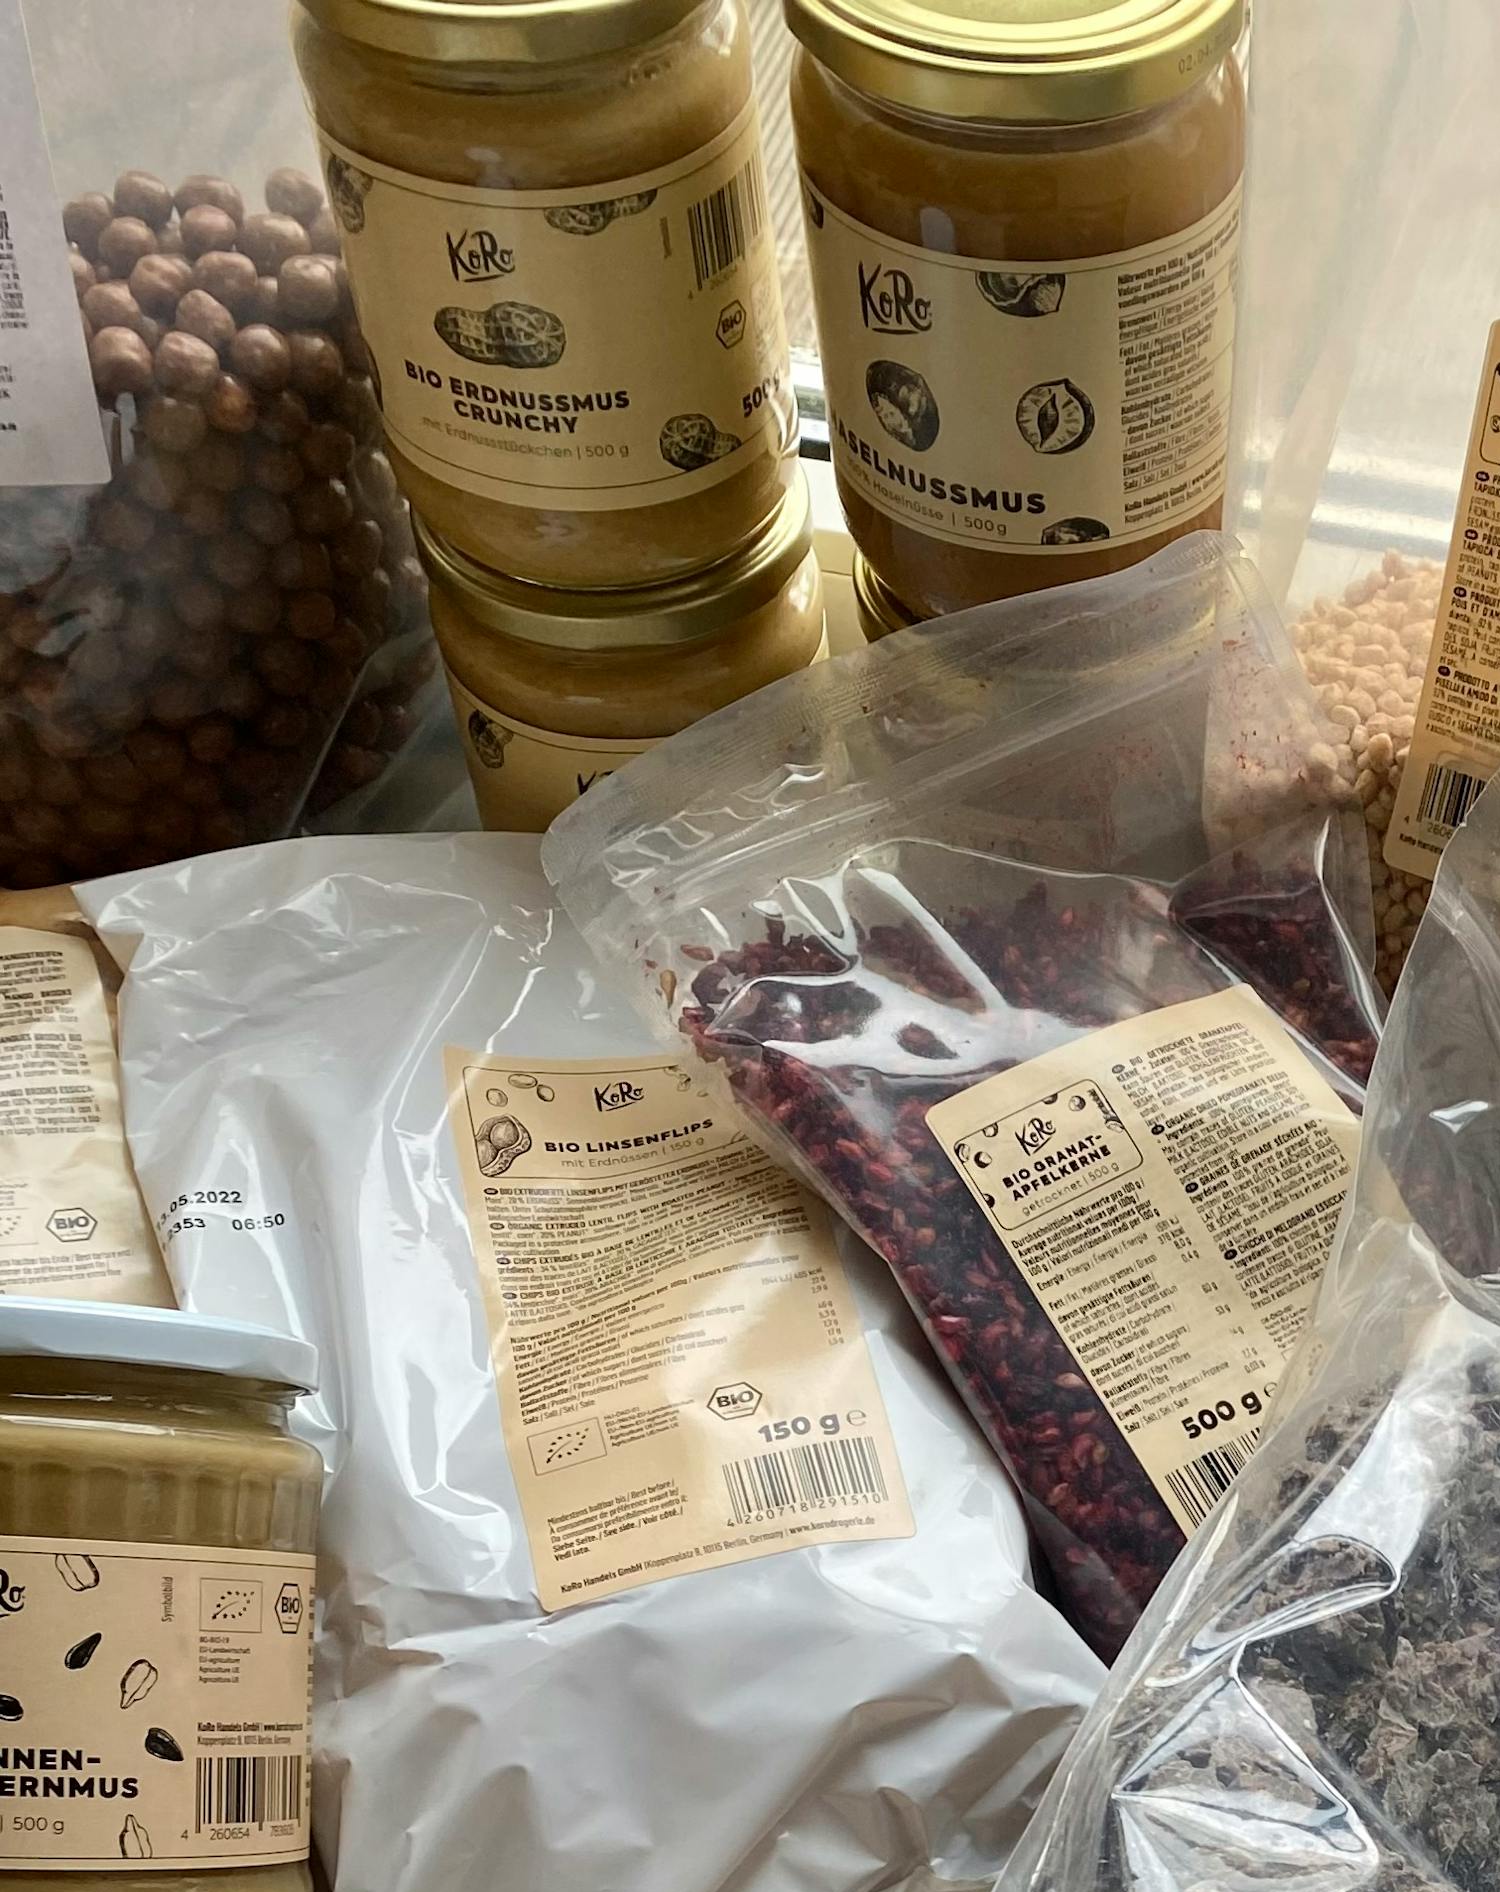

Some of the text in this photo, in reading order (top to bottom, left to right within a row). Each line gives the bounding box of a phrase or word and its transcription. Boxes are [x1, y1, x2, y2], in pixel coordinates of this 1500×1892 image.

[446, 229, 516, 282] KoRo
[858, 261, 932, 334] KoRo
[721, 309, 743, 334] BIO
[404, 359, 631, 411] BIO ERDNUSSMUS
[454, 400, 578, 433] CRUNCHY
[585, 445, 615, 458] 500
[594, 1081, 644, 1111] KoRo
[545, 1118, 714, 1153] BIO LINSENFLIPS
[1015, 1117, 1057, 1156] KoRo
[561, 1158, 585, 1169] mit
[588, 1148, 660, 1168] Erdnüssen
[1002, 1135, 1102, 1189] BIO GRANAT-
[1012, 1145, 1112, 1201] APFELKERNE
[1022, 1181, 1083, 1217] getrocknet
[1088, 1164, 1110, 1182] 500
[54, 1216, 89, 1229] BIO
[232, 1213, 285, 1231] 06:50
[715, 1391, 755, 1409] BIO
[1181, 1391, 1263, 1440] 500 g
[757, 1412, 841, 1443] 150 g
[561, 1580, 582, 1594] KoRo
[583, 1570, 617, 1588] Handels
[617, 1563, 643, 1578] GmbH
[161, 1576, 173, 1623] Symbolbild
[281, 1597, 300, 1614] BIO
[12, 1817, 64, 1835] 500 g
[209, 1828, 251, 1841] 260654
